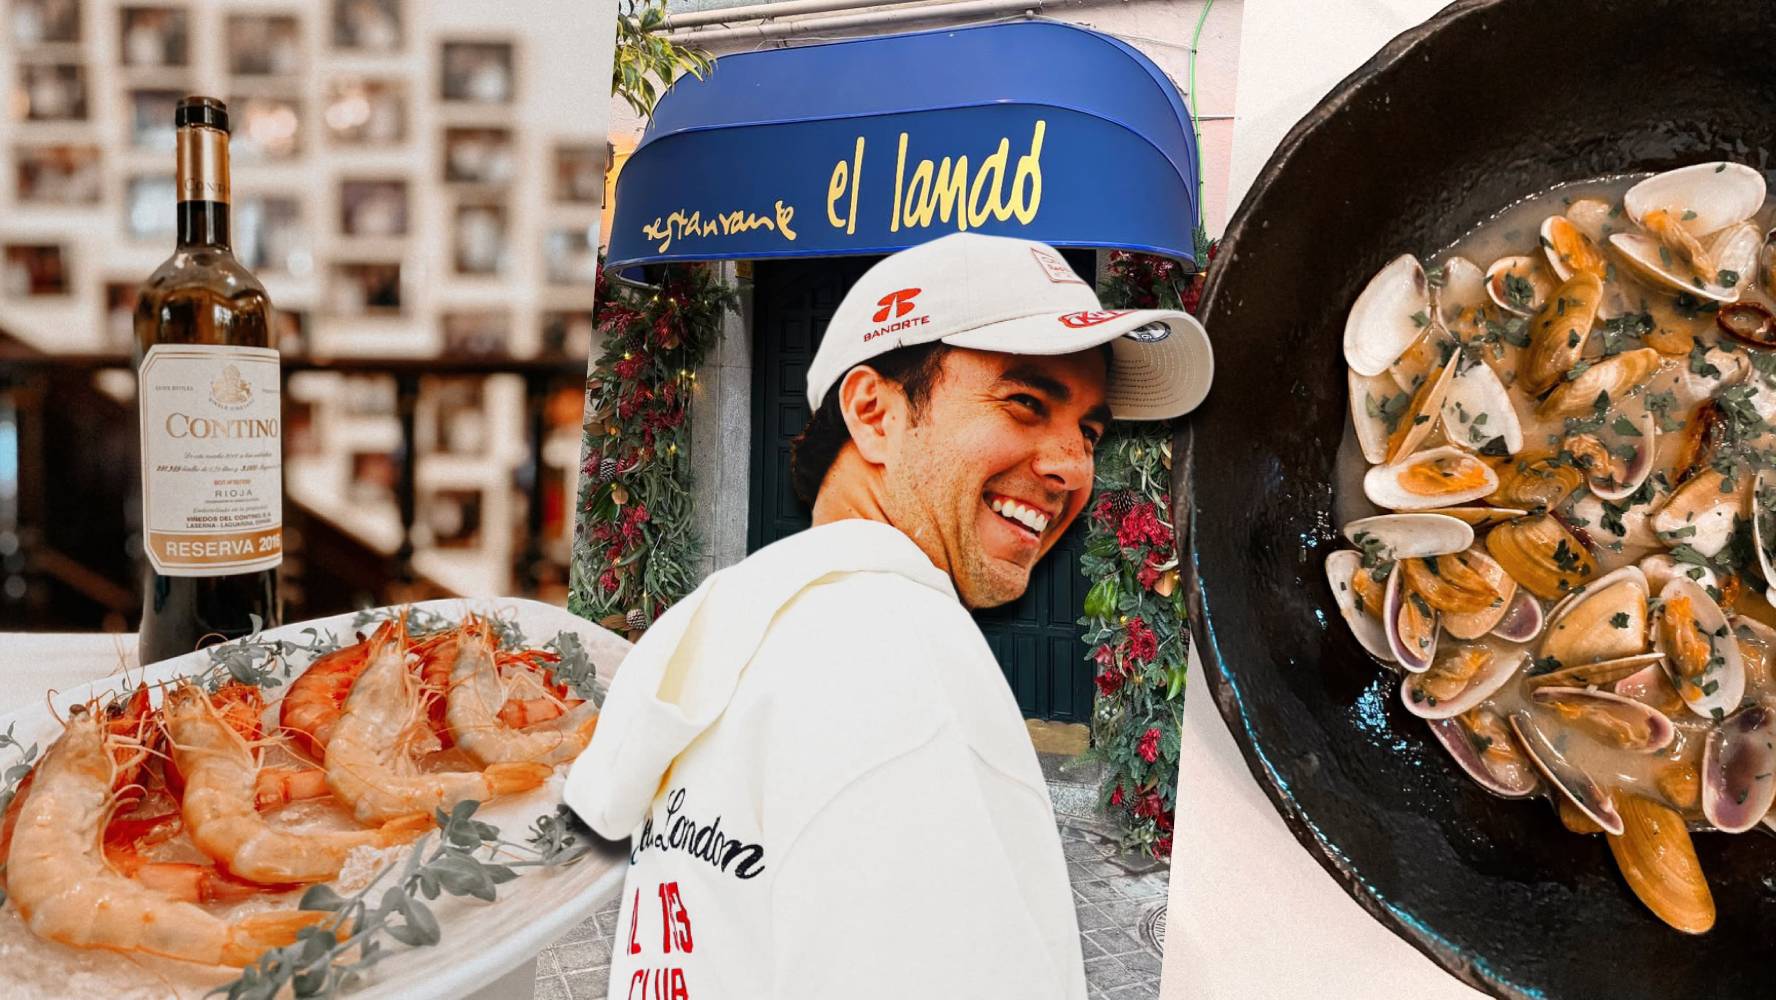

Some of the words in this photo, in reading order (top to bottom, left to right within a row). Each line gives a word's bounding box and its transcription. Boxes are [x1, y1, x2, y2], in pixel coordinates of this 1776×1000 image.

[827, 136, 865, 235] el
[863, 315, 930, 342] BANORTE
[166, 412, 278, 439] CONTINO
[214, 489, 253, 498] RIOJA
[166, 539, 254, 557] RESERVA
[655, 788, 766, 879] London
